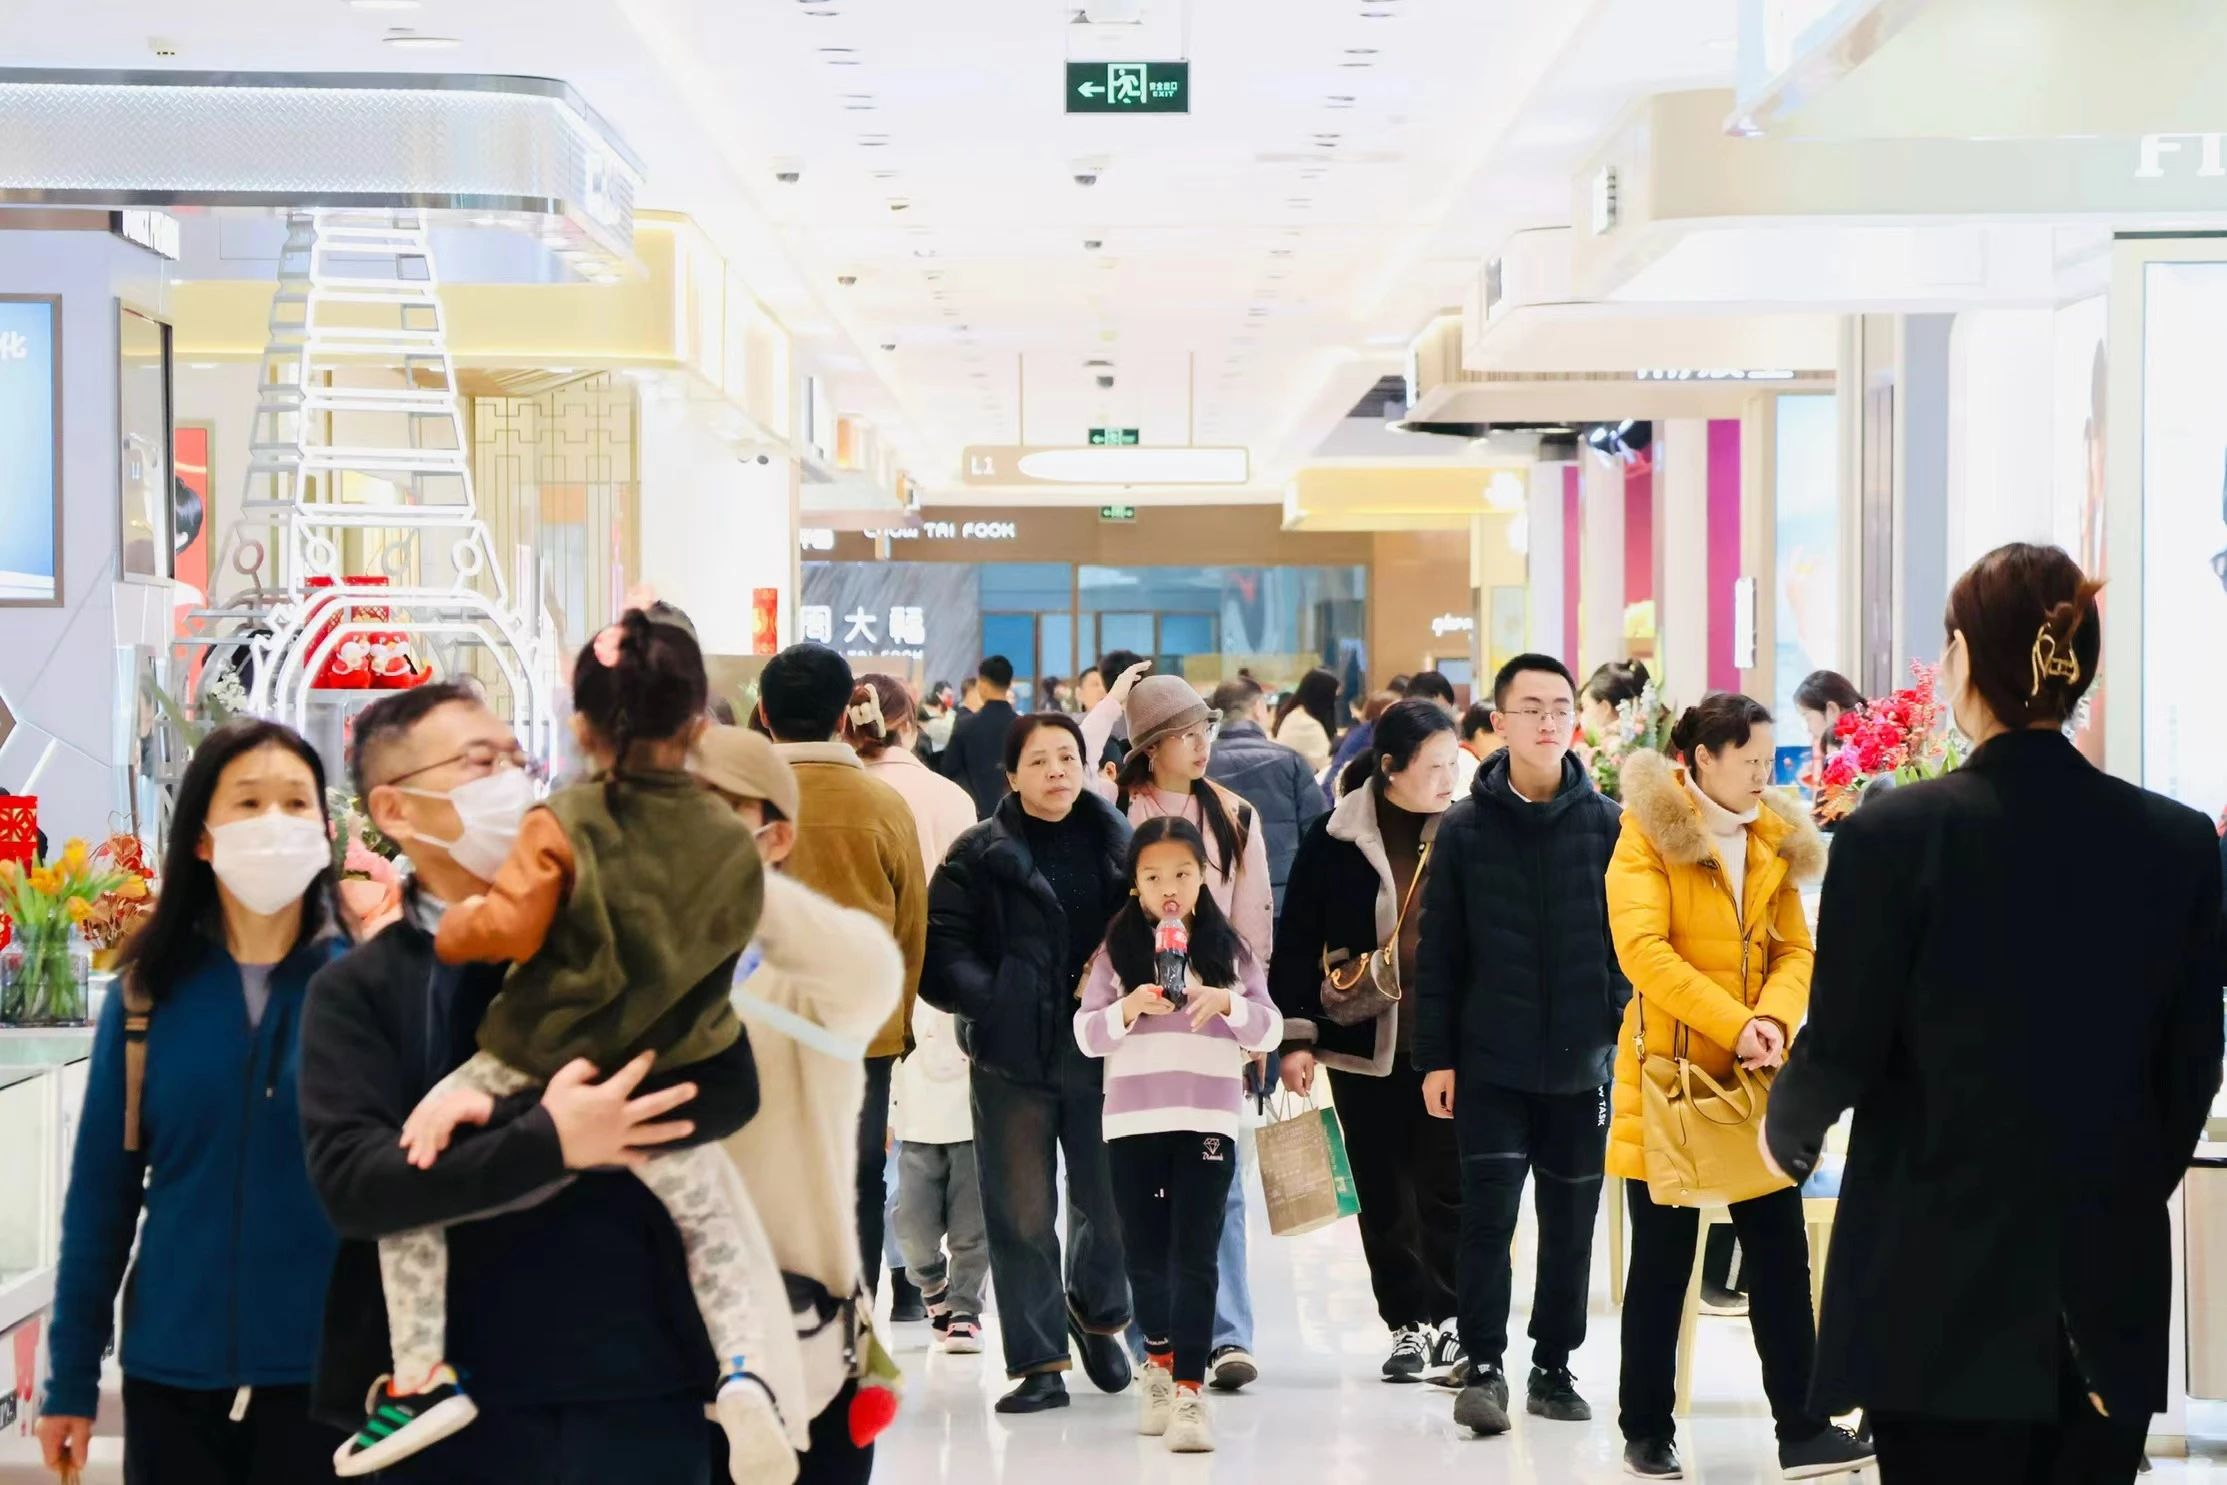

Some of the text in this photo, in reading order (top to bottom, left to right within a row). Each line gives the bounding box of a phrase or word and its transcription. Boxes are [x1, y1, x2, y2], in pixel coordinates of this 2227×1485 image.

[970, 455, 995, 476] L1
[923, 522, 955, 539] TAI
[962, 522, 1016, 539] FOOK
[1597, 1100, 1607, 1127] TASK
